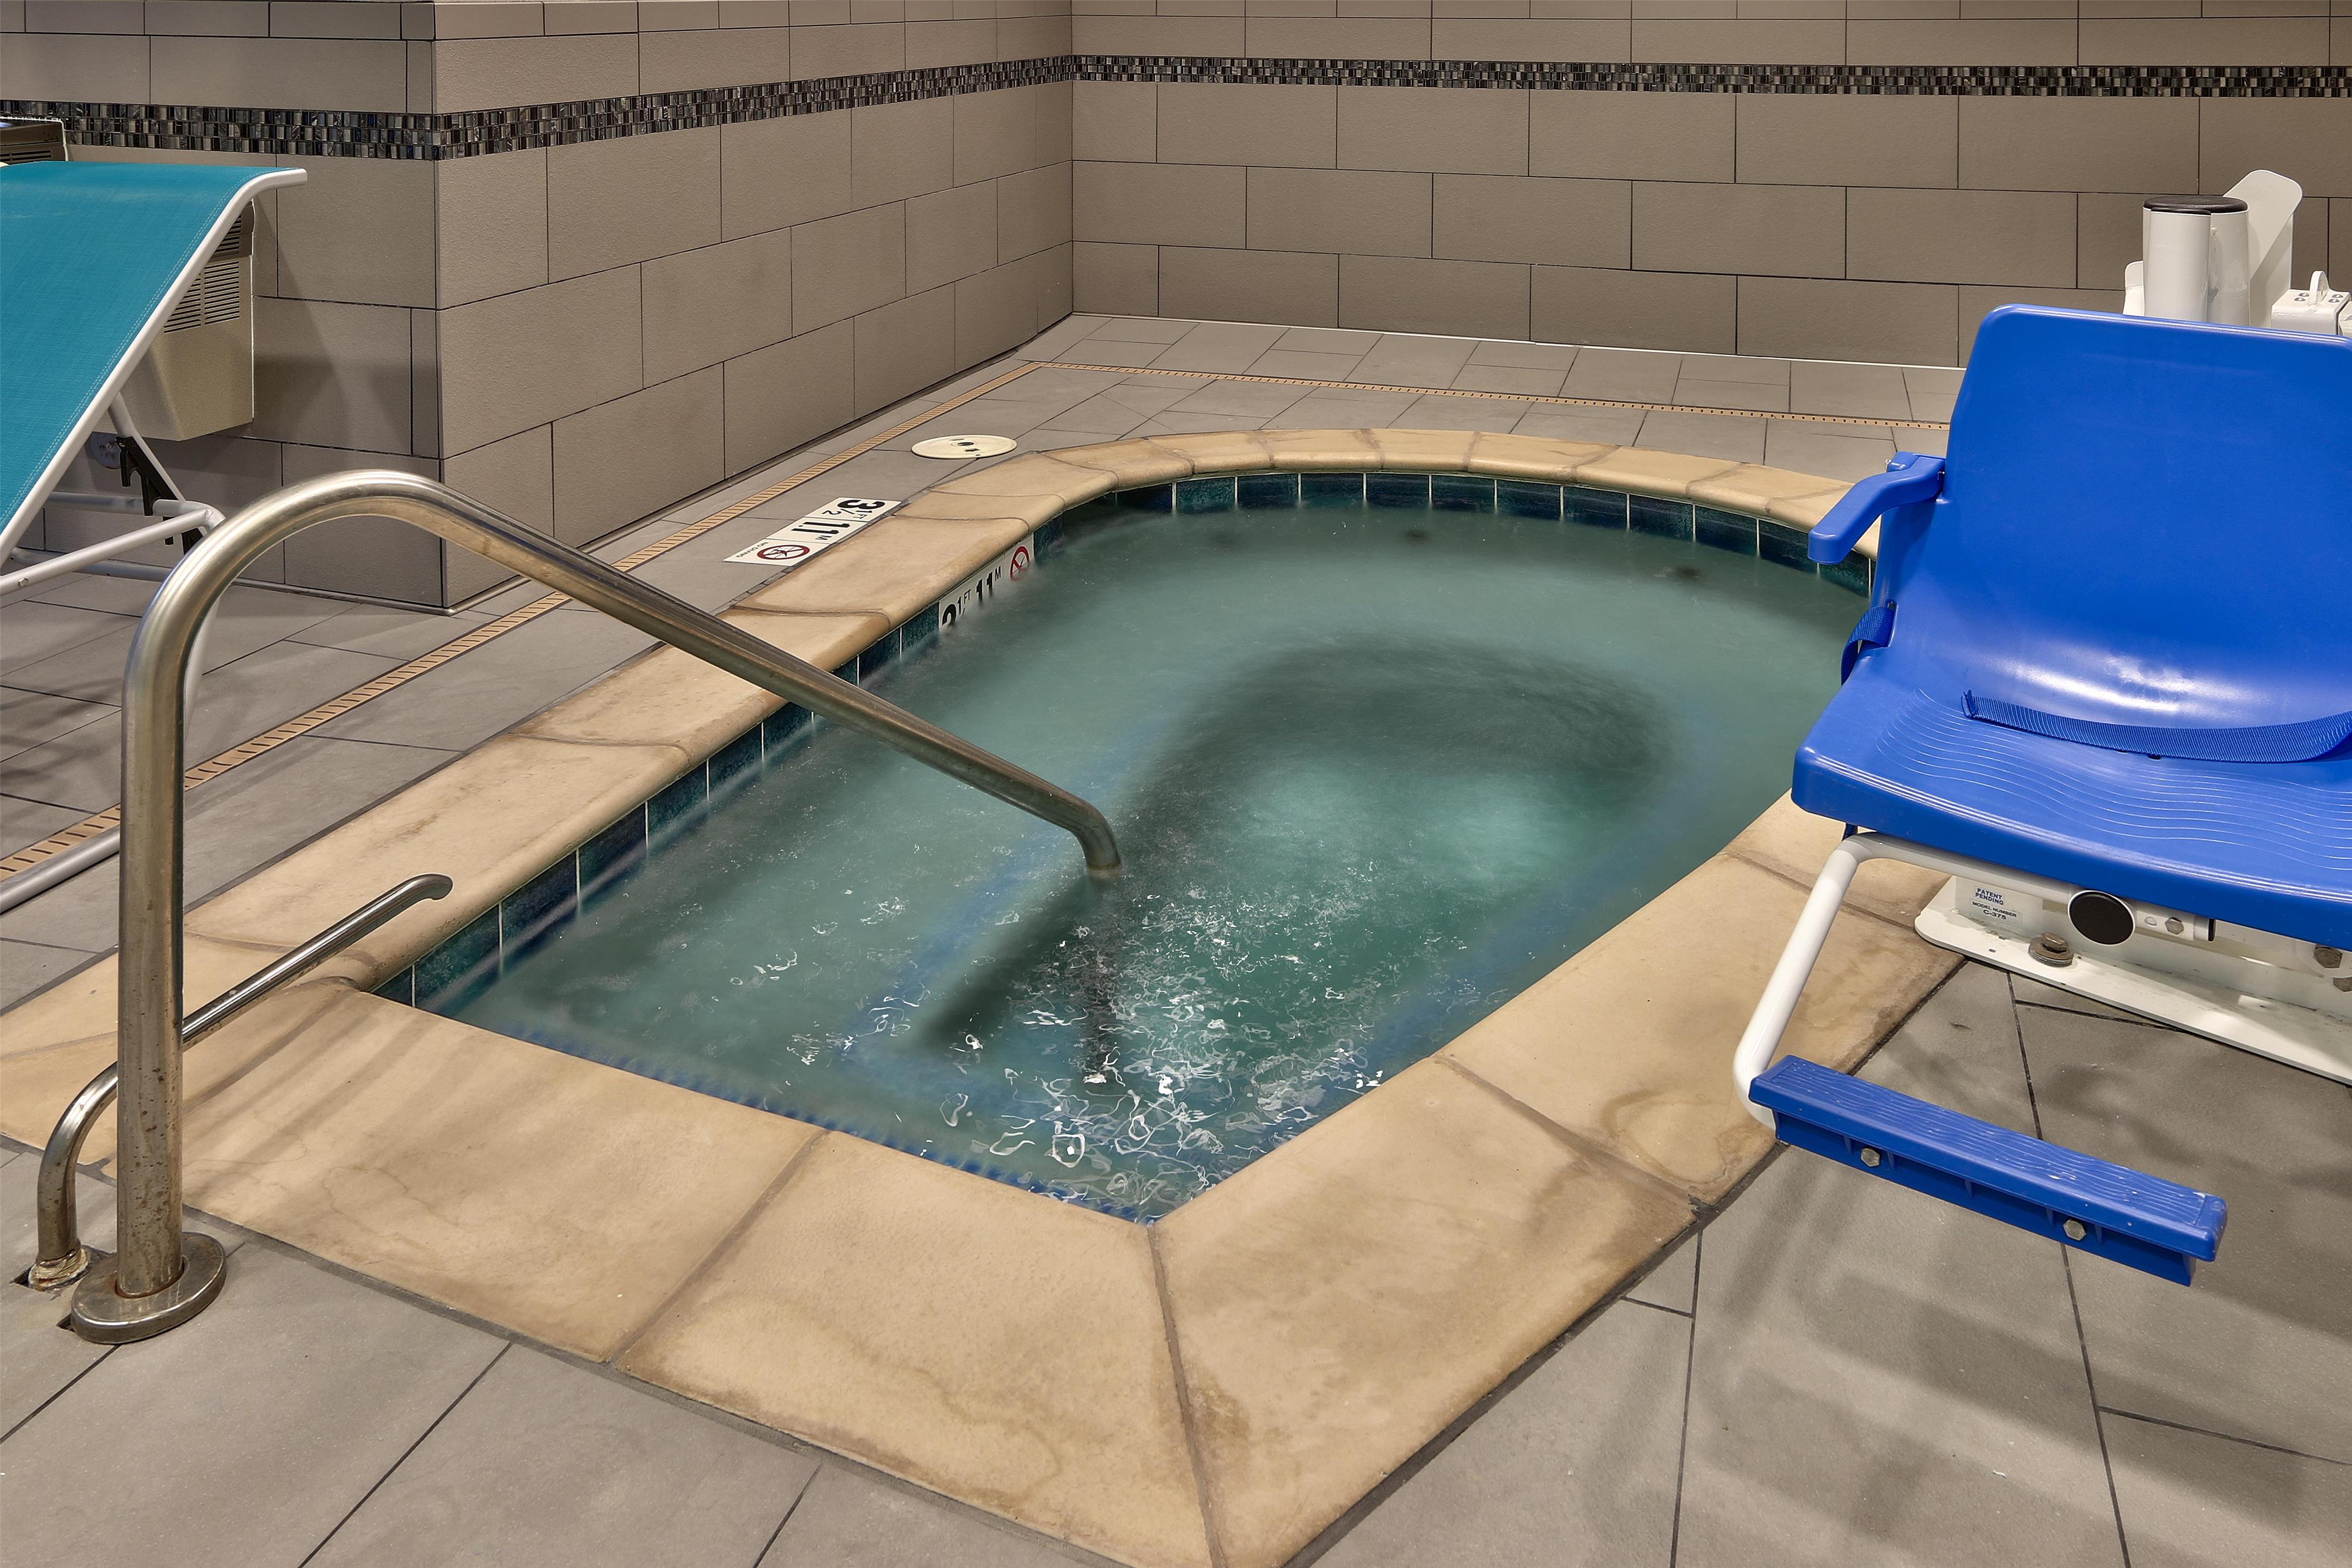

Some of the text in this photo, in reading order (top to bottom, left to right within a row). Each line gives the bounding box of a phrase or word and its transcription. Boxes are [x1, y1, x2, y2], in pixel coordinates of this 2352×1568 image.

[837, 499, 885, 510] 3
[995, 566, 1001, 581] M
[1975, 893, 2004, 905] PENDING
[1977, 888, 2002, 899] PATENT
[1973, 901, 2017, 917] MODEL NUMBER
[1983, 909, 2007, 920] C-375
